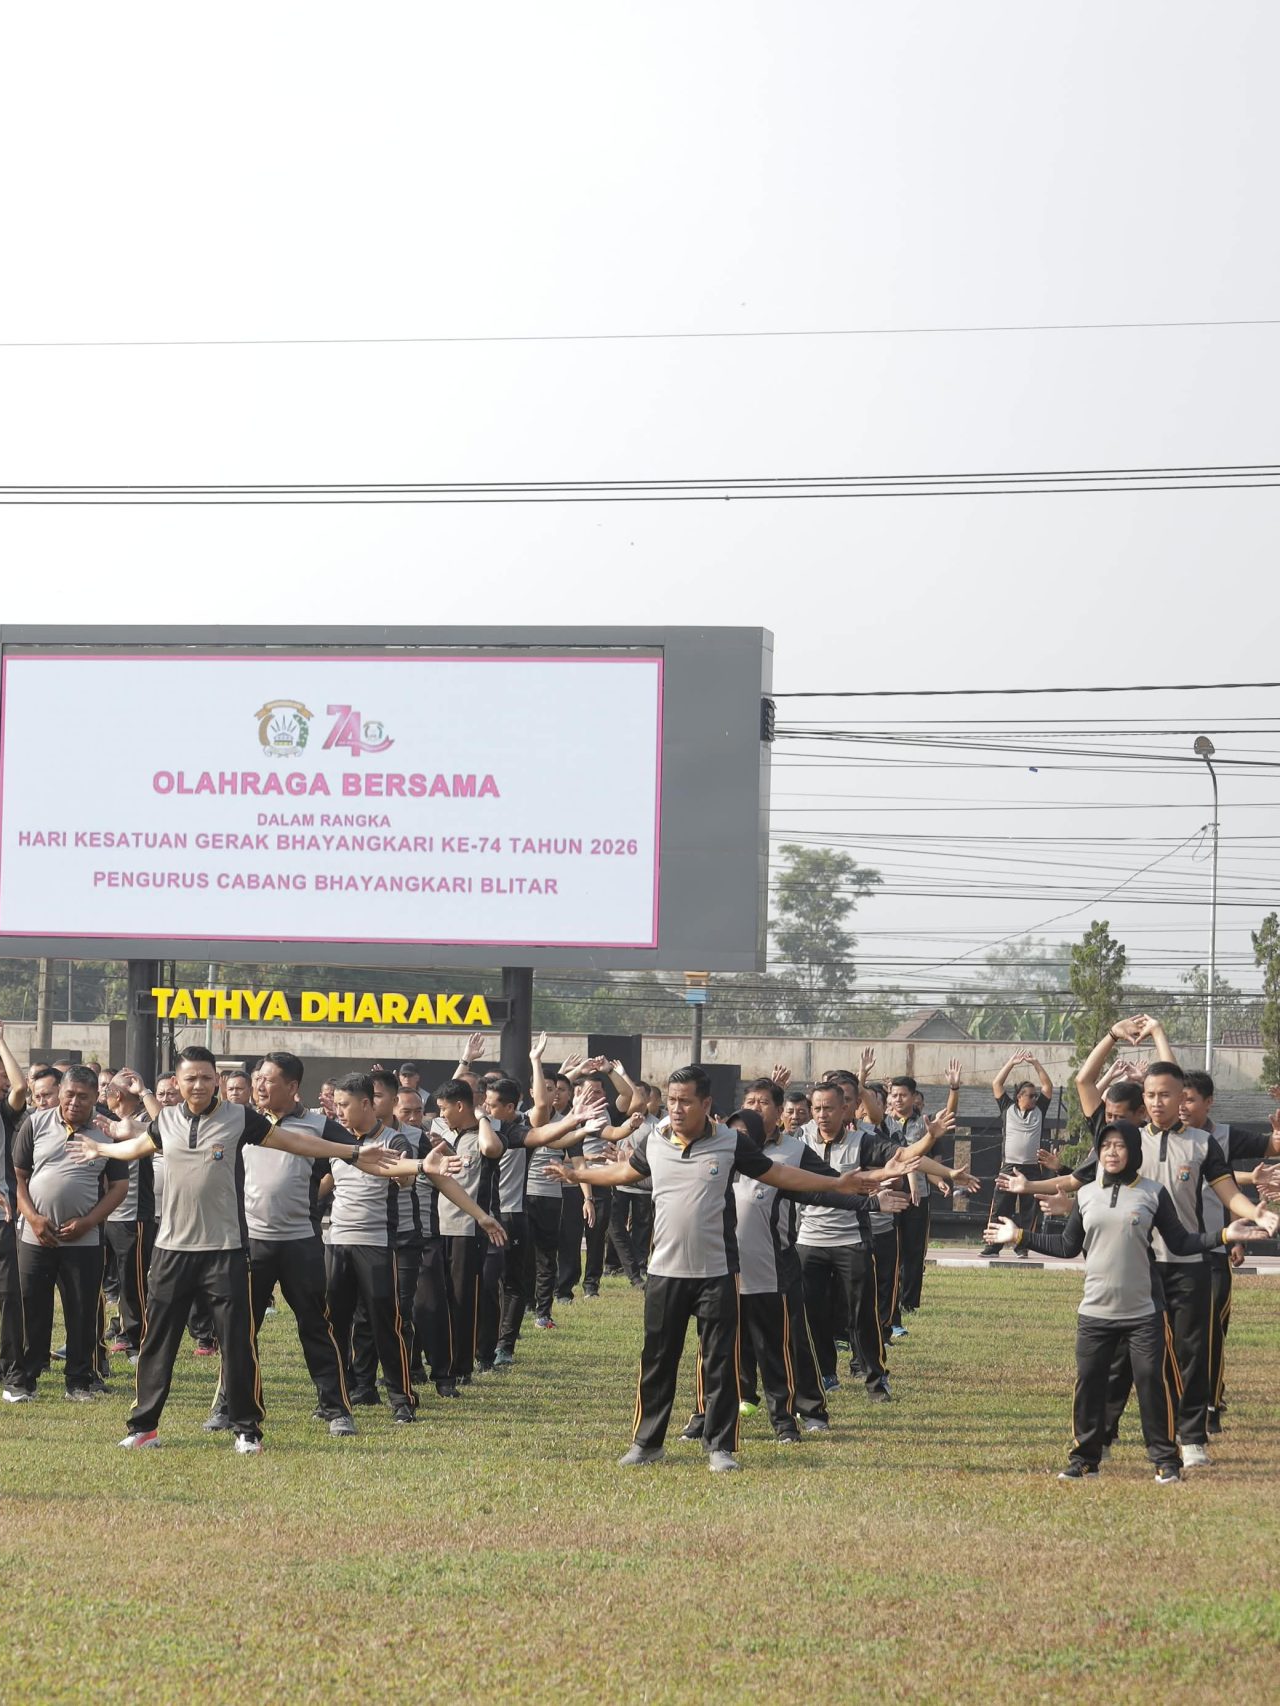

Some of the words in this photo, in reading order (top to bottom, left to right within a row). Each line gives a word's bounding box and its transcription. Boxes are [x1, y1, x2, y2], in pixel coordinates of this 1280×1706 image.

[322, 704, 361, 757] 74
[152, 770, 331, 797] OLAHRAGA
[341, 772, 501, 799] BERSAMA
[258, 814, 315, 826] DALAM
[321, 815, 390, 827] RANGKA
[18, 832, 67, 846] HARI
[75, 832, 188, 848] KESATUAN
[195, 832, 269, 849] GERAK
[277, 833, 433, 852] BHAYANGKARI
[441, 836, 501, 853] KE-74
[510, 838, 583, 855] TAHUN
[591, 839, 637, 856] 2026
[94, 872, 209, 889] PENGURUS
[216, 873, 307, 890] CABANG
[315, 875, 472, 894] BHAYANGKARI
[481, 877, 557, 896] BLITAR
[152, 988, 290, 1021] TATHYA
[301, 992, 490, 1025] DHARAKA
